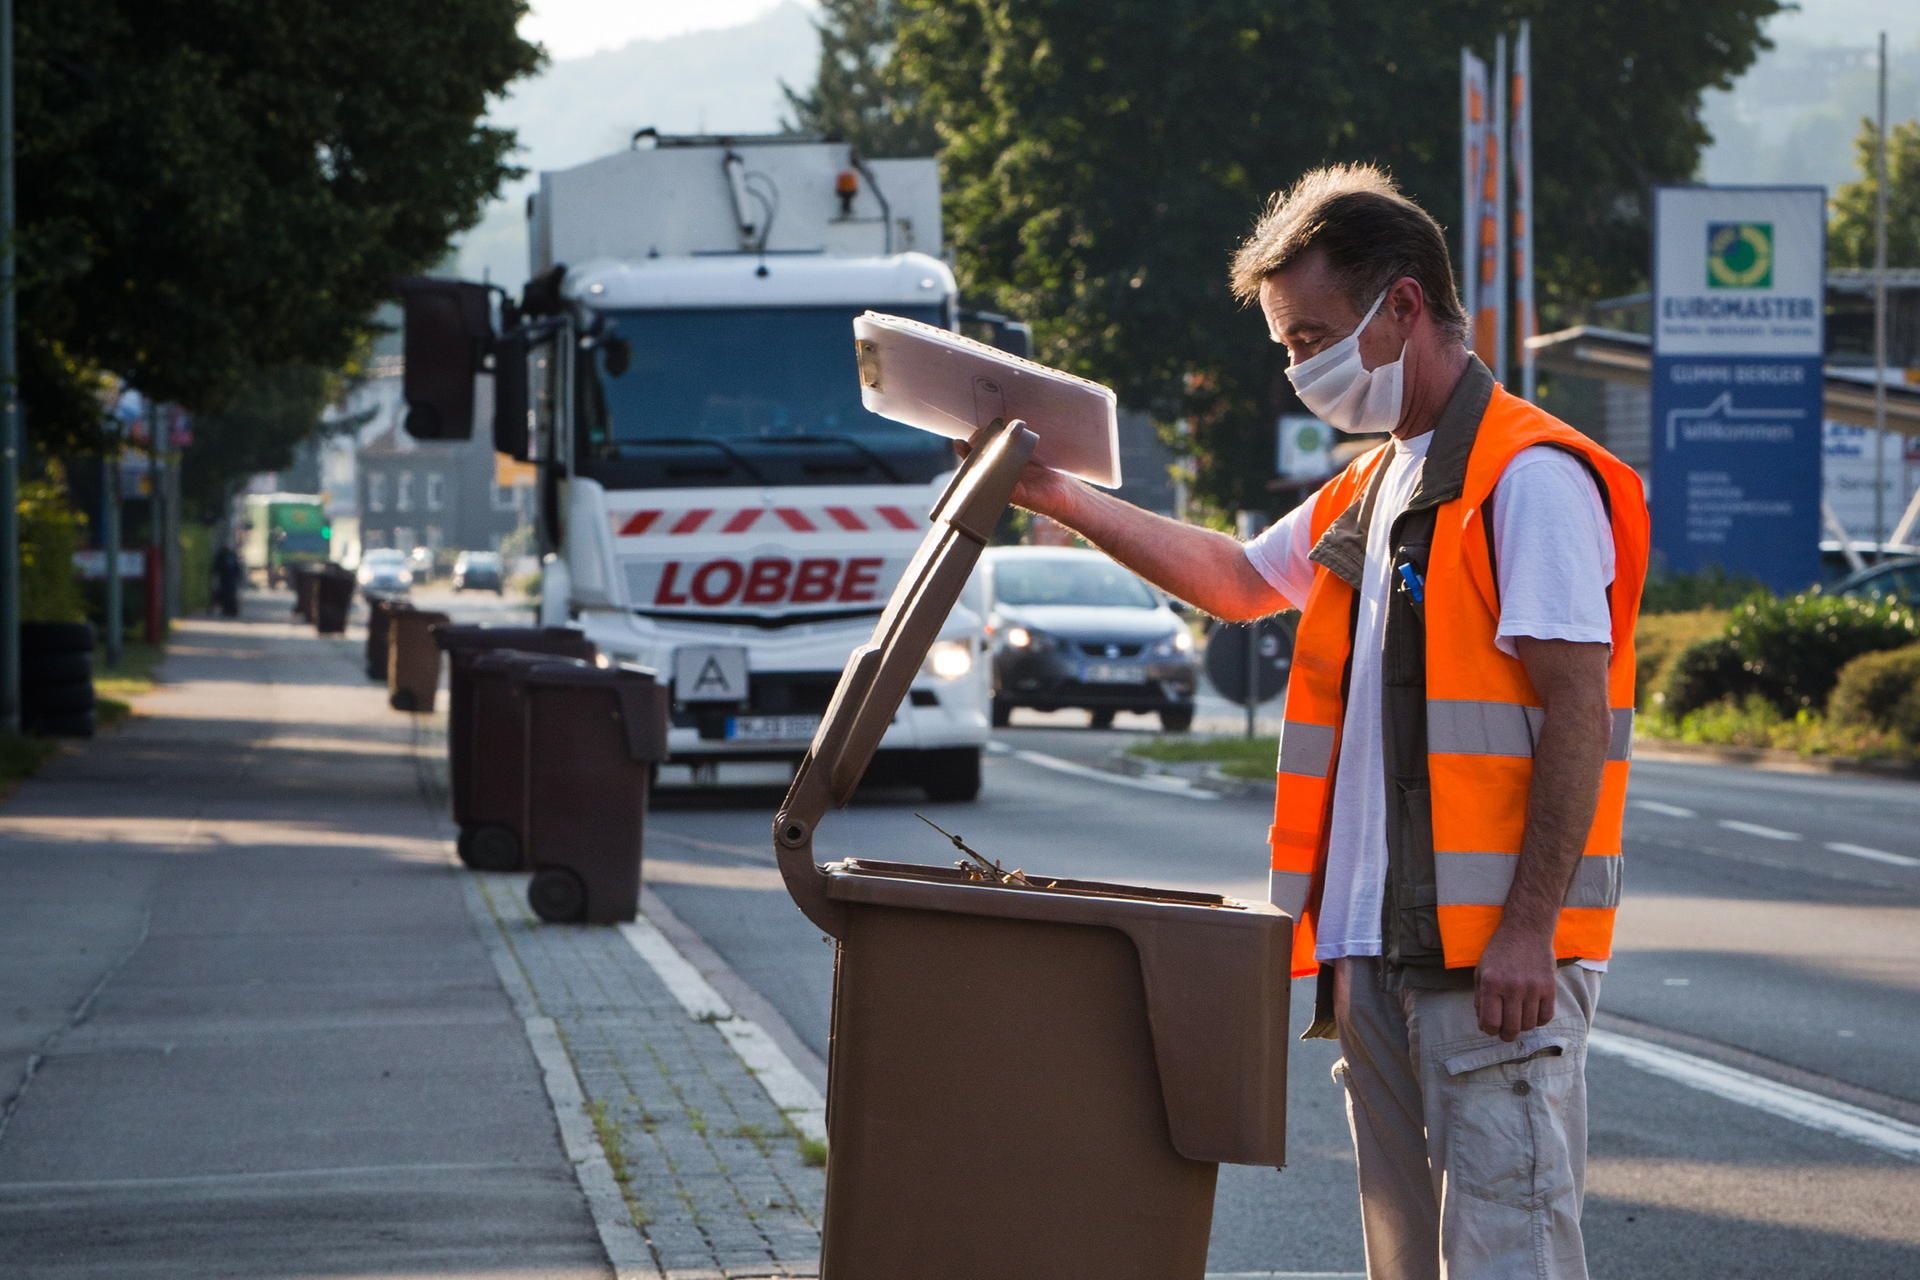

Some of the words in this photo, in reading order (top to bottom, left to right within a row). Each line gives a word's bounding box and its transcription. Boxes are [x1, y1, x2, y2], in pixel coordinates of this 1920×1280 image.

[1663, 296, 1814, 320] EUROMASTER
[654, 557, 884, 607] LOBBE
[693, 654, 731, 692] A
